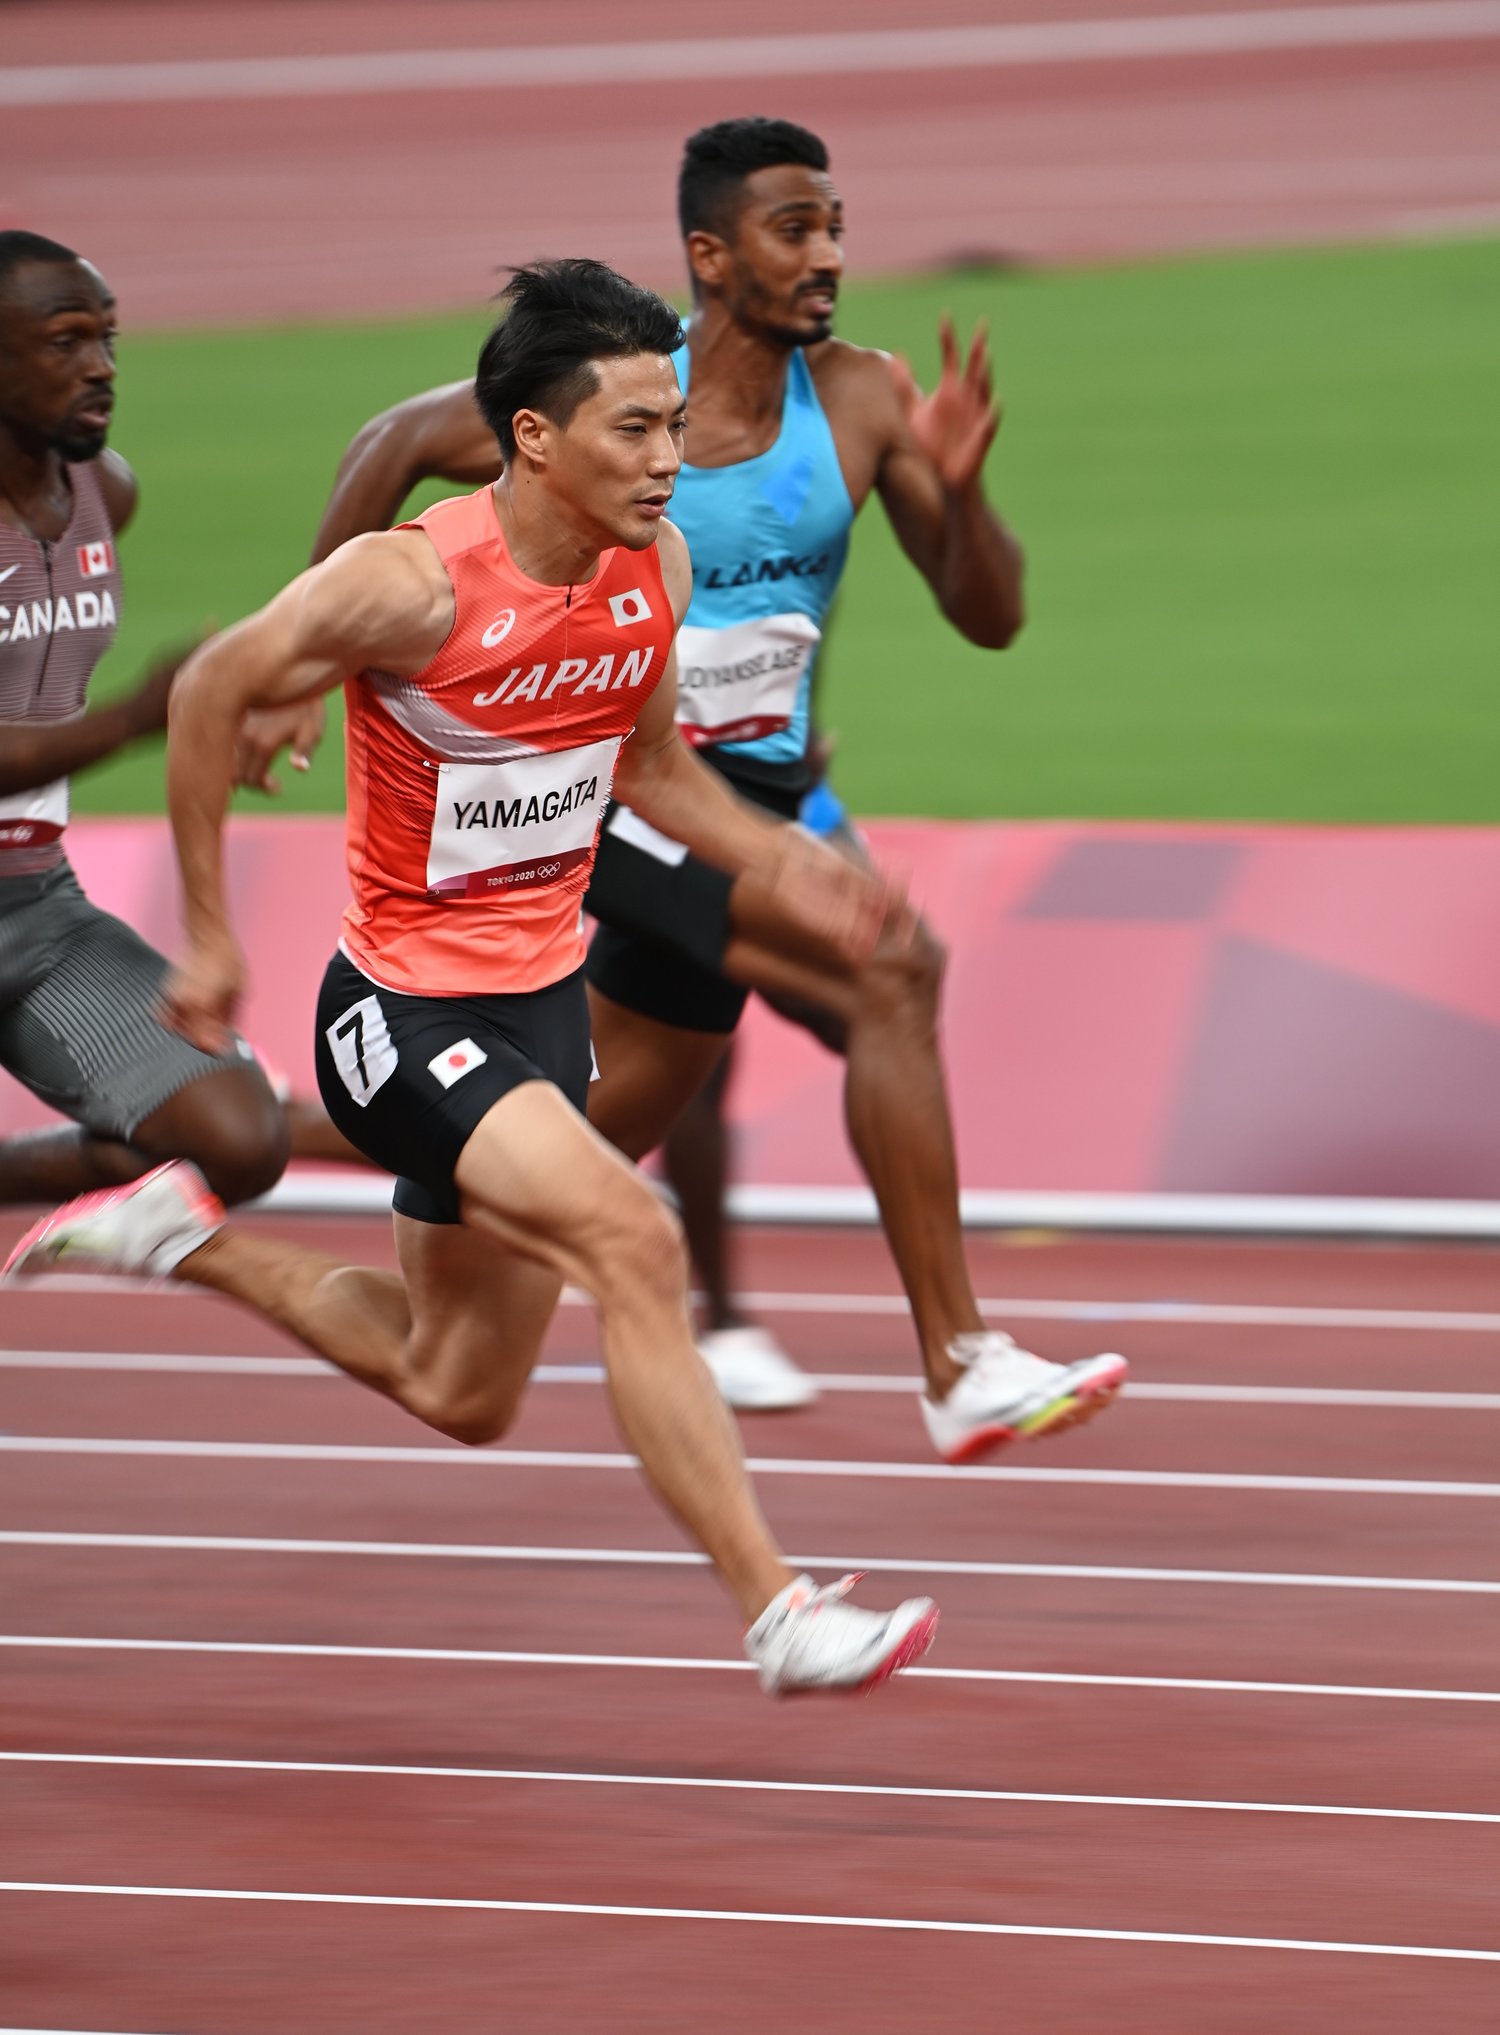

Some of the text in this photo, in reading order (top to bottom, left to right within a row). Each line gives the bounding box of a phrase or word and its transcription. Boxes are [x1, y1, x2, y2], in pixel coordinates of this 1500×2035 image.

[472, 646, 654, 707] JAPAN
[453, 776, 598, 830] YAMAGATA
[487, 871, 535, 886] TOKYO 2020
[336, 1010, 369, 1091] 7
